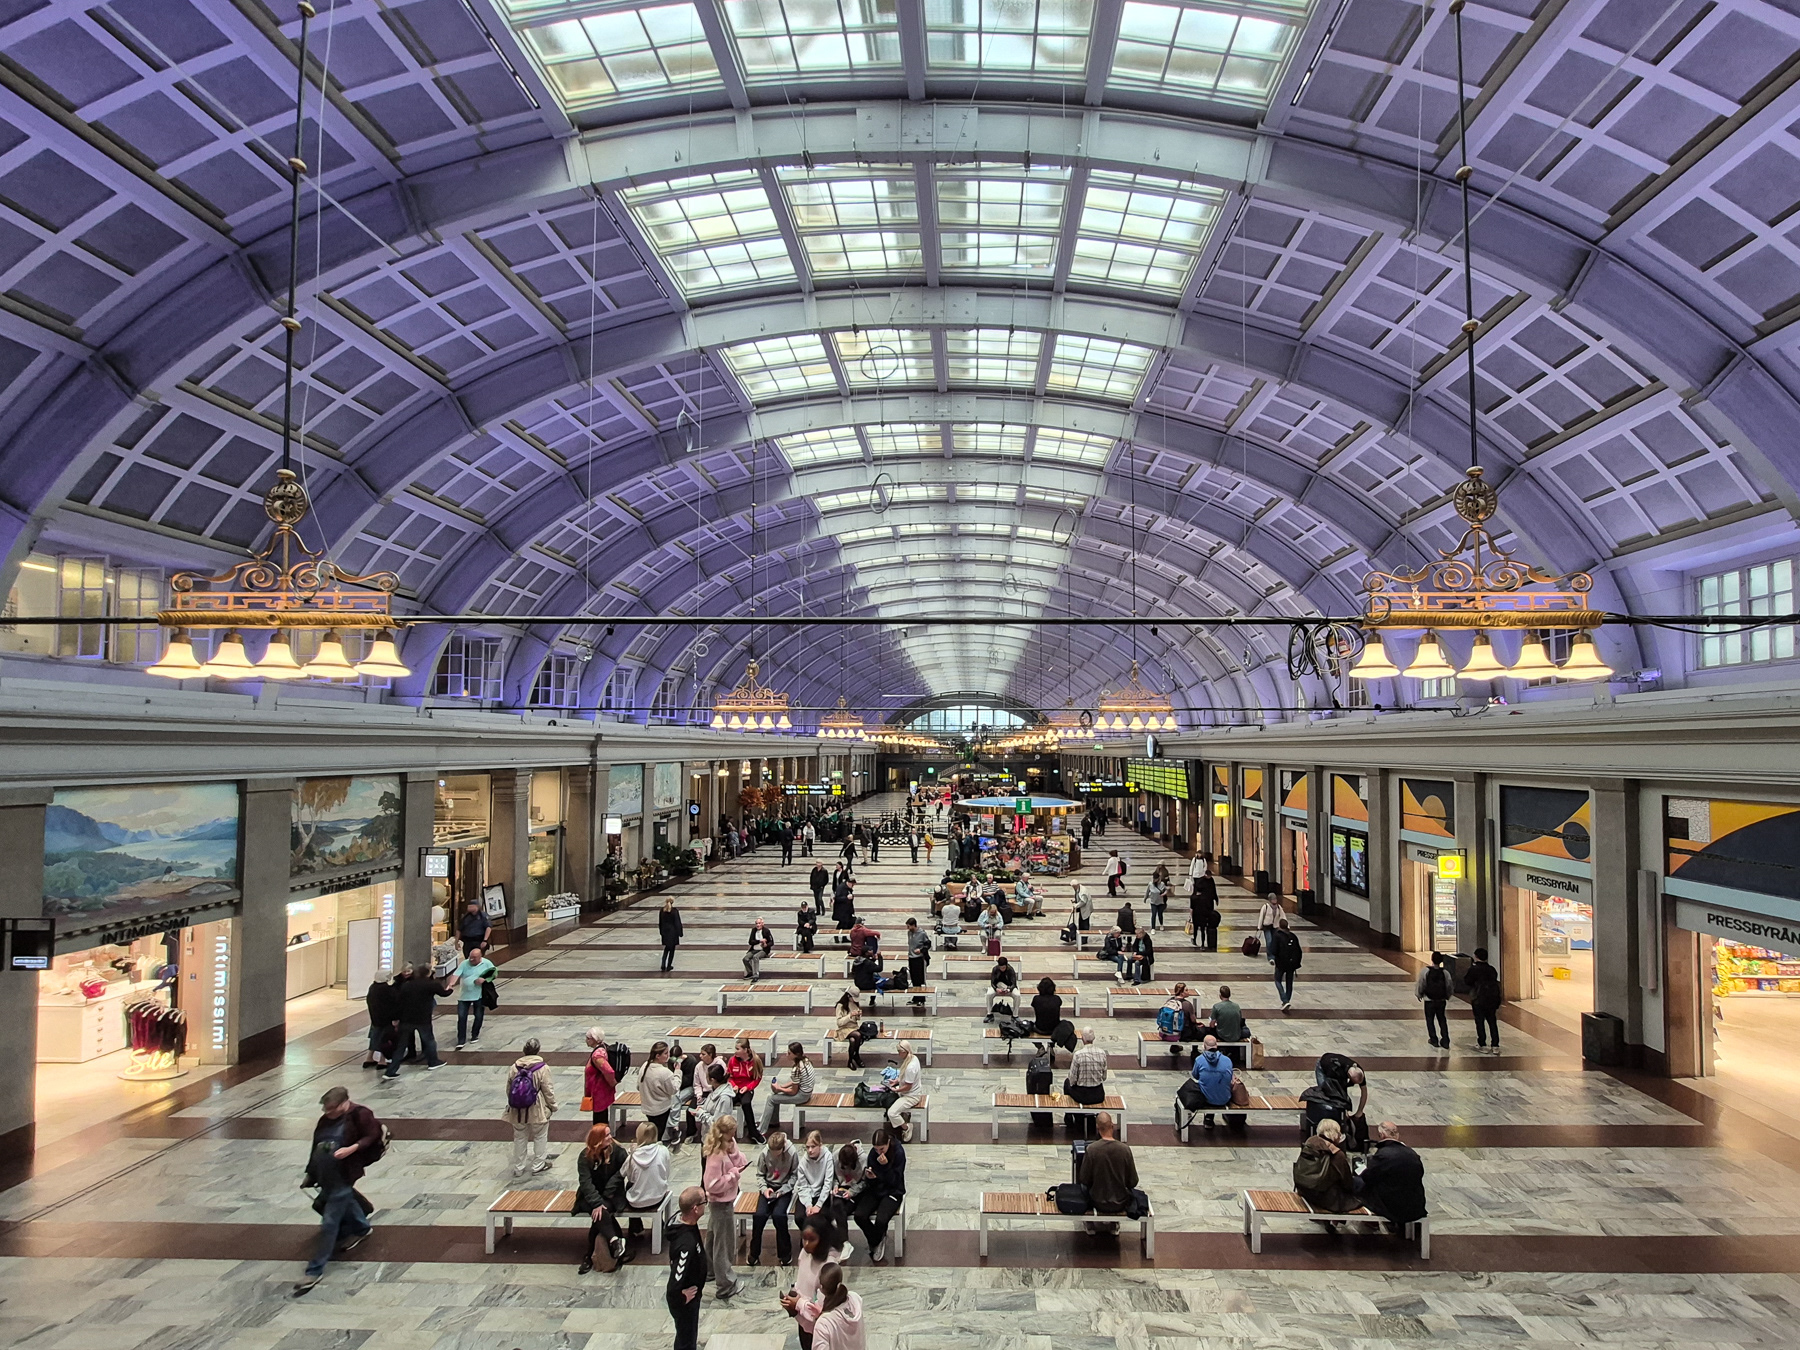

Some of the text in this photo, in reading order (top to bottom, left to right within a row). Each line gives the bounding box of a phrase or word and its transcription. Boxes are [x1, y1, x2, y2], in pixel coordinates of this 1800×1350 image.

[320, 877, 372, 894] INTIMISSIMI
[1526, 873, 1579, 894] PRESSBYRÅN
[101, 916, 190, 945] INTIMISSIMI
[380, 894, 394, 969] intimissi
[1707, 913, 1800, 945] PRESSBYRÅN
[212, 935, 229, 1049] intimissimi
[124, 1048, 173, 1075] Silk
